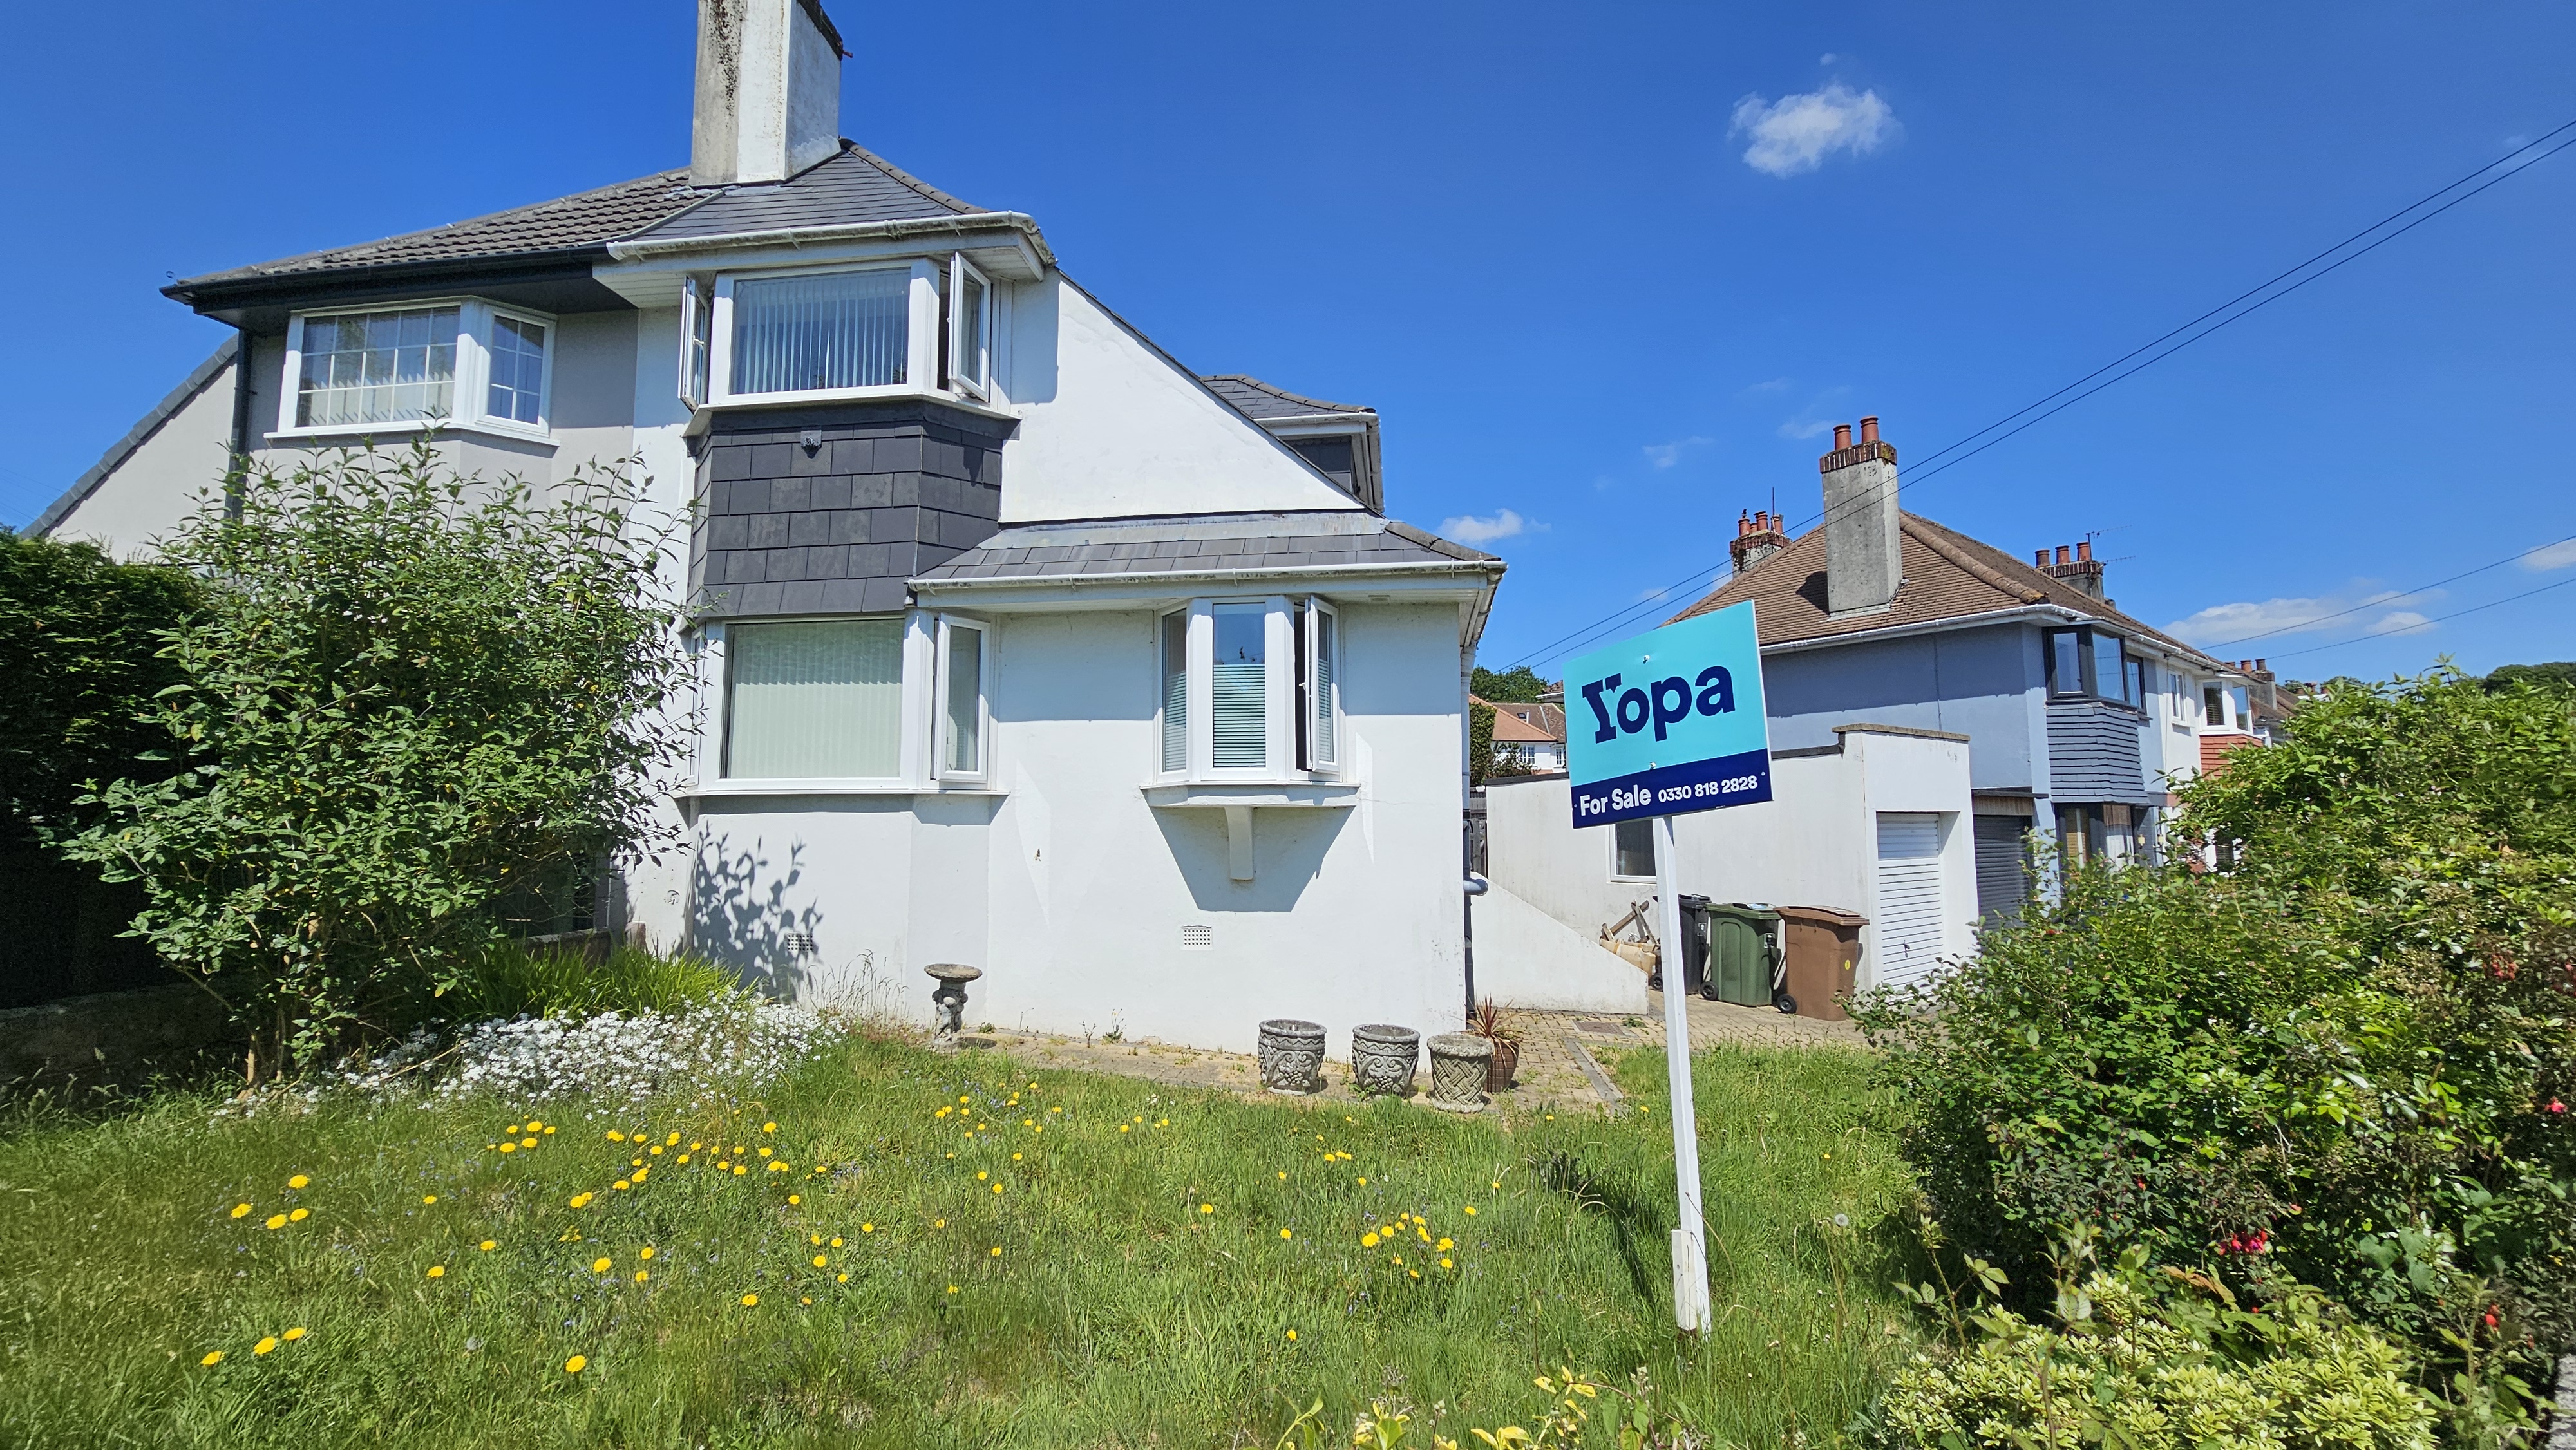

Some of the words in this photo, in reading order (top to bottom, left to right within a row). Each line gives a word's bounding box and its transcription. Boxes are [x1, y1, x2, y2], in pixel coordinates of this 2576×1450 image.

[1582, 666, 1736, 744] Yopa
[1580, 795, 1609, 816] For
[1611, 784, 1651, 811] Sale
[1658, 785, 1692, 803] 0330
[1694, 781, 1719, 797] 818
[1721, 775, 1758, 793] 2828
